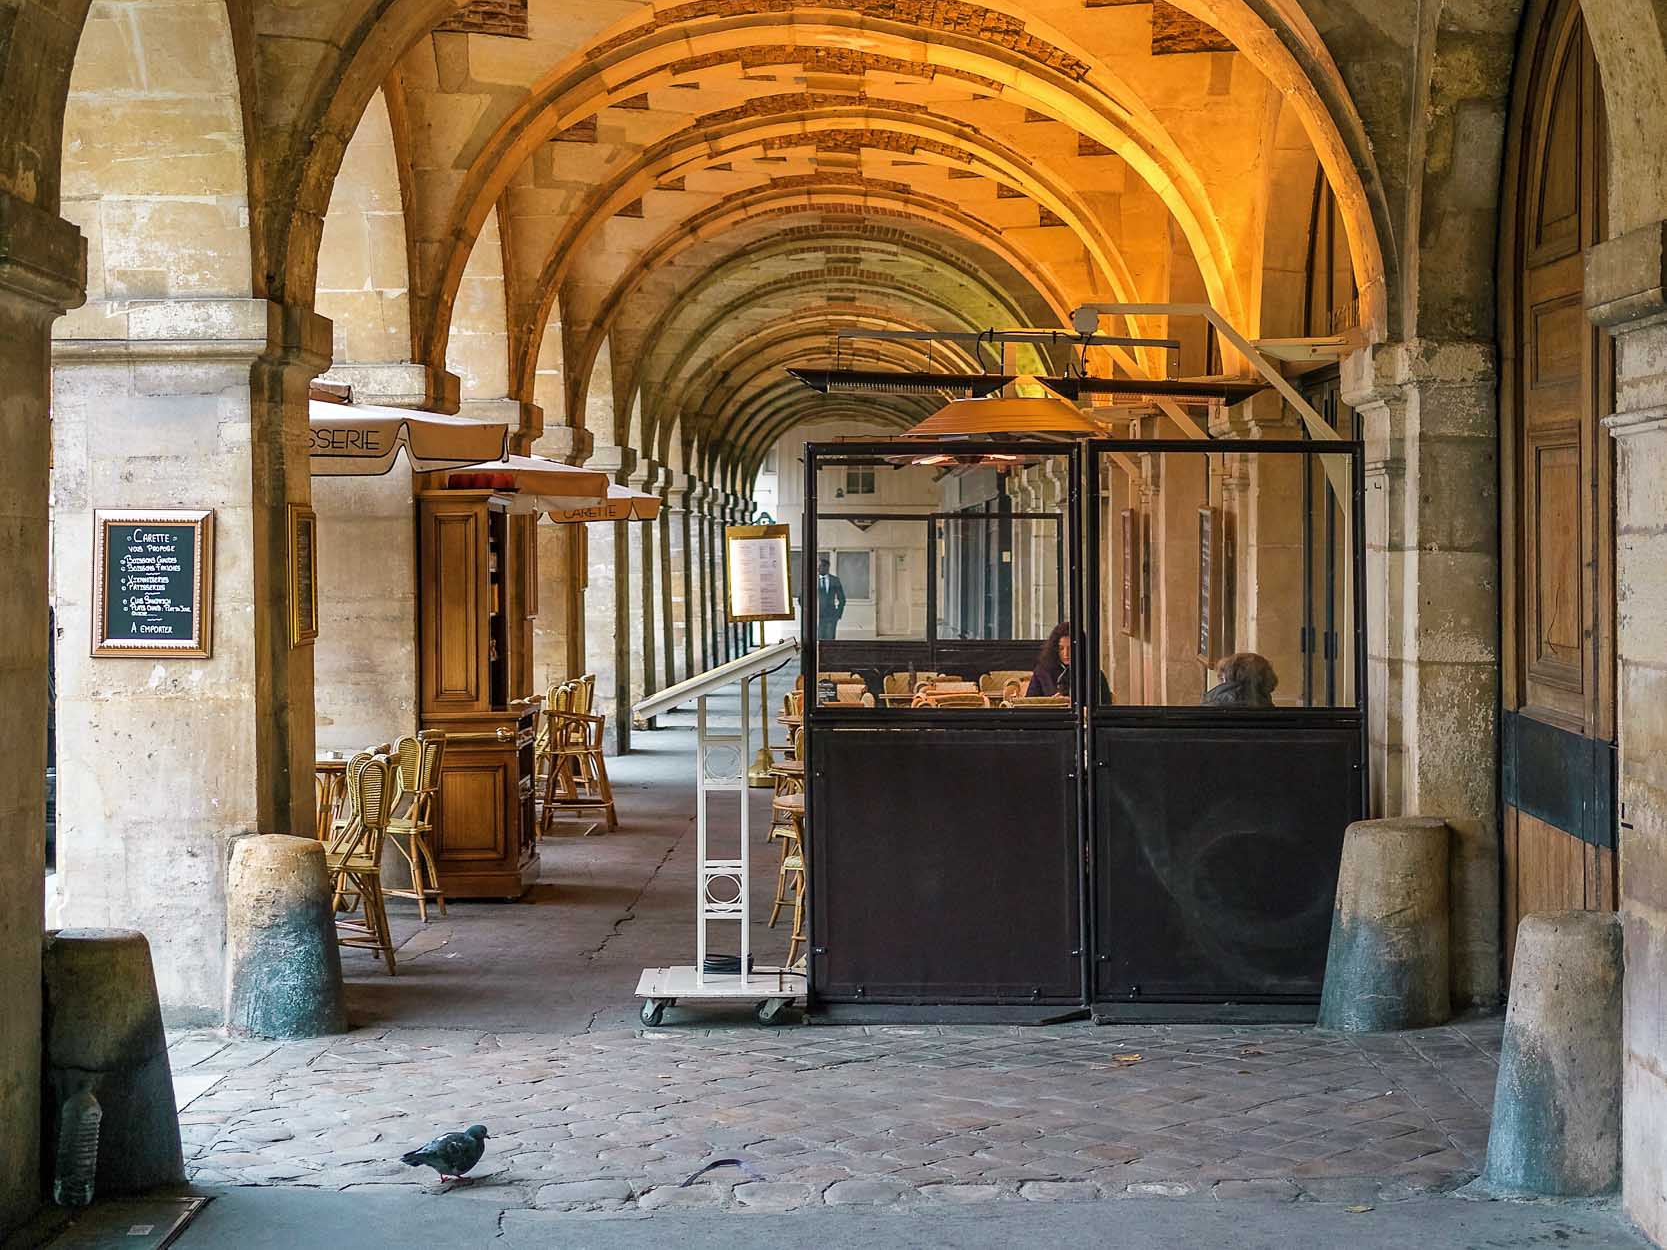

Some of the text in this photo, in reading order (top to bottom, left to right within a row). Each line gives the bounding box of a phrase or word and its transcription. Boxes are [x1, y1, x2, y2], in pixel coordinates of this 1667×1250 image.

[563, 504, 617, 519] CARETTE
[133, 528, 170, 543] CARETTE
[128, 544, 176, 553] VOUS PROPOSE
[124, 555, 156, 564] BOISSONS
[127, 563, 156, 572] BOISSONS
[140, 625, 173, 634] EMPORTER
